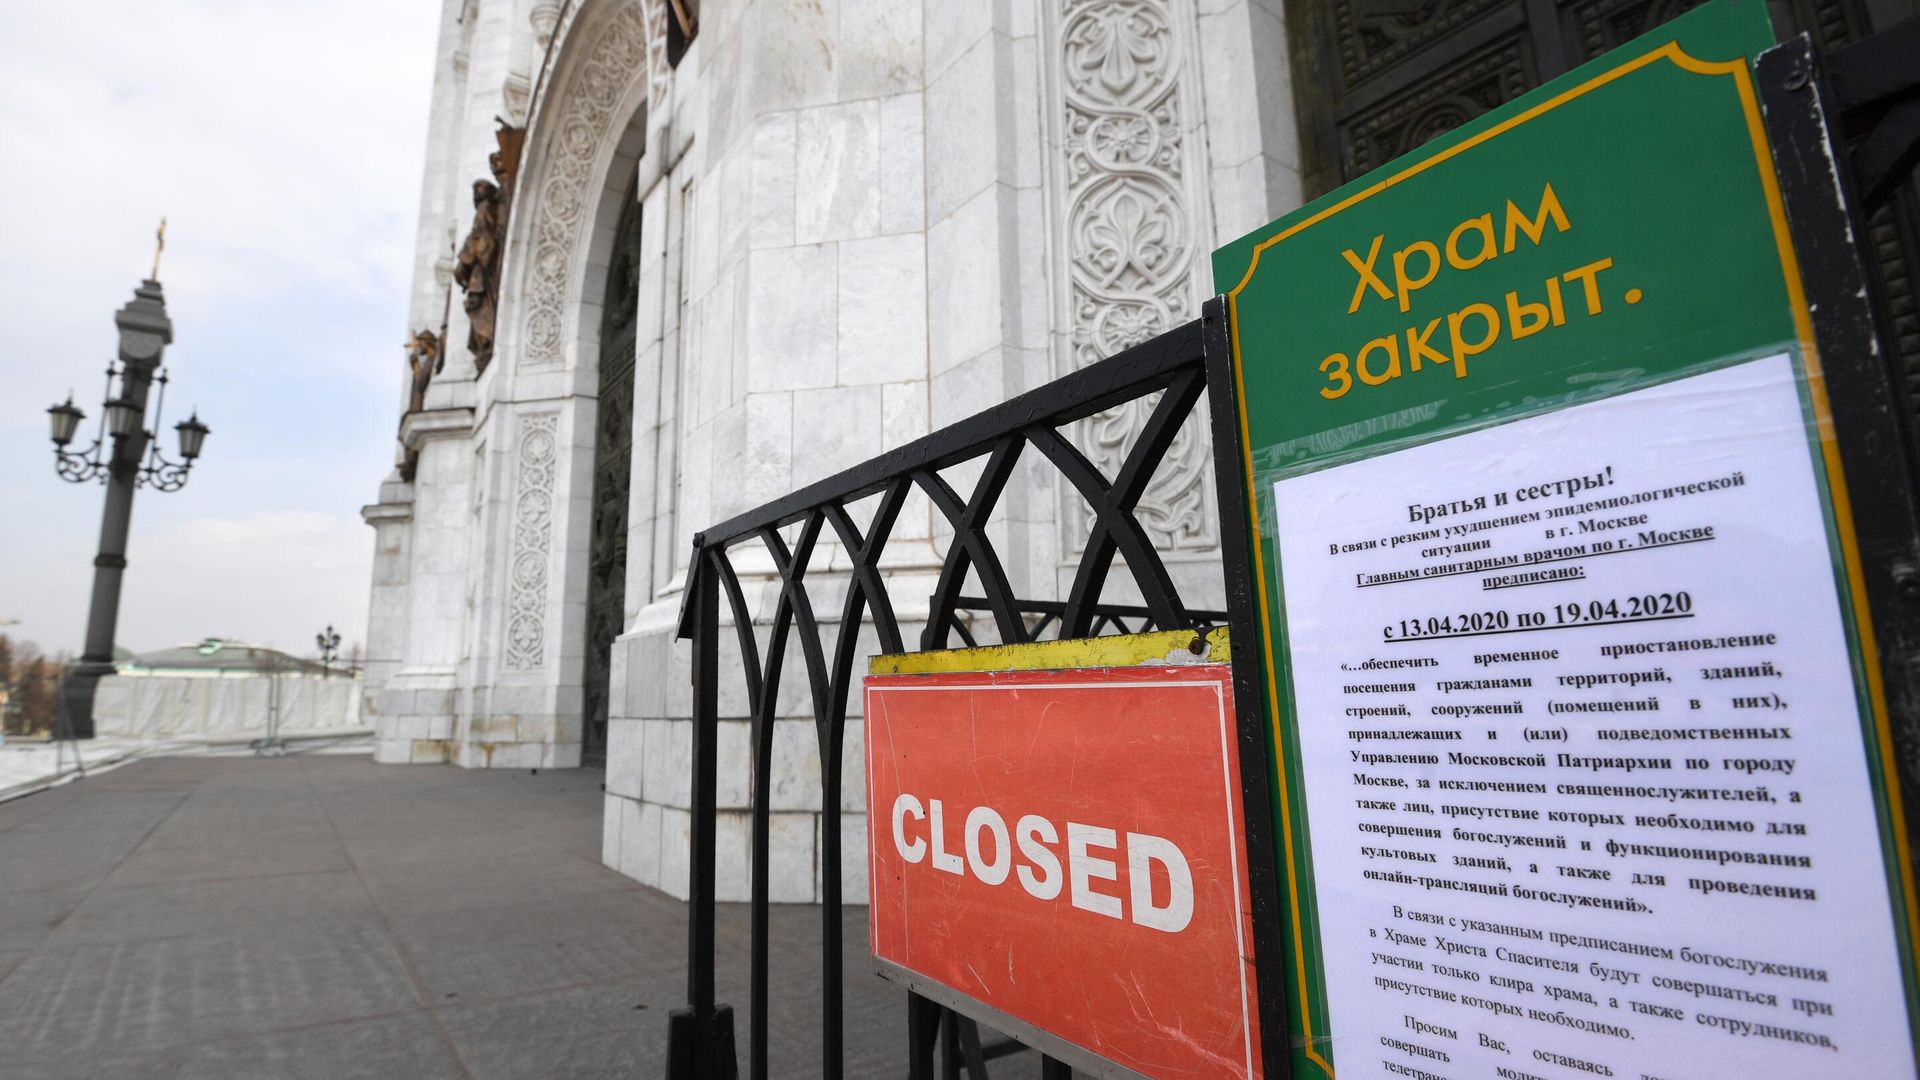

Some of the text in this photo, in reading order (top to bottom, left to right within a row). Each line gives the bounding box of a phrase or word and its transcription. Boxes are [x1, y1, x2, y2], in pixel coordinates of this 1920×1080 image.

[1341, 181, 1571, 315] Храм
[1318, 256, 1643, 400] закрыт.
[1329, 471, 1745, 555] В связи с резким ухудшением эпидемиологической
[1407, 466, 1614, 524] Братья и сестры!
[1357, 525, 1714, 585] Главным санитарным врачом по г. Москве
[1421, 513, 1648, 558] ситуации в г. Москве
[1482, 564, 1585, 589] предписано:
[1384, 591, 1692, 638] с 13.04.2020 по 19.04.2020
[1474, 649, 1559, 666] временное
[1601, 633, 1776, 658] приостановление
[1343, 661, 1783, 695] посещения гражданами территорий, зданий,
[1346, 692, 1787, 718] строений, сооружений (помещений в них),
[1348, 726, 1792, 743] принадлежащих и (или) подведомственных
[1351, 750, 1796, 774] Управлению Московской Патриархии по городу
[1354, 773, 1802, 804] Москве, за исключением священнослужителей, а
[1356, 799, 1807, 836] также лиц, присутствие которых необходимо для
[892, 793, 1194, 933] CLOSED
[1358, 821, 1812, 868] совершения богослужений и функционирования
[1361, 845, 1816, 901] культовых зданий, а также для проведения
[1364, 868, 1653, 914] онлайн-трансляций богослужений».
[1393, 906, 1828, 982] В связи с указанным предписанием богослужения
[1370, 928, 1833, 1017] в Храме Христа Спасителя будут совершаться при
[1371, 951, 1838, 1051] участии только клира храма, а также сотрудников,
[1374, 976, 1635, 1040] присутствие которых необходимо.
[1380, 1036, 1450, 1062] совершать
[1404, 1015, 1613, 1077] Просим Вас, оставаясь
